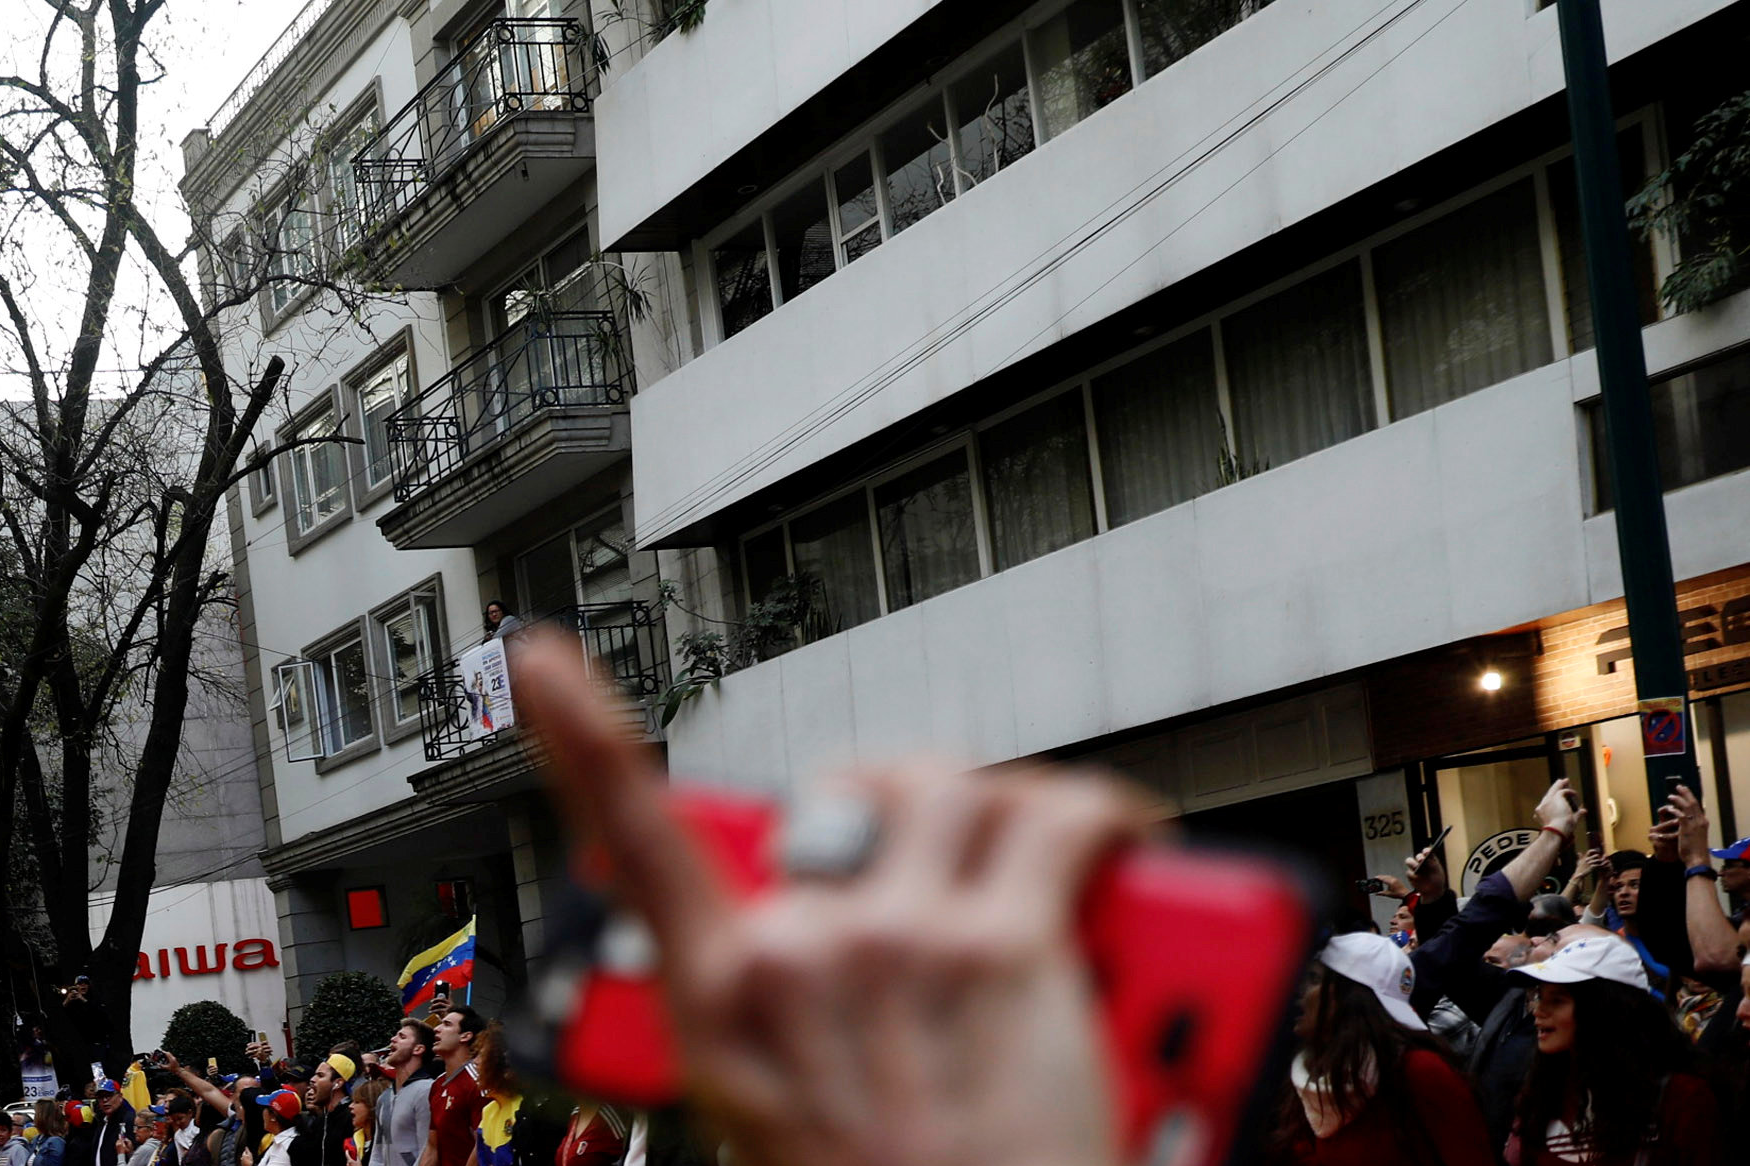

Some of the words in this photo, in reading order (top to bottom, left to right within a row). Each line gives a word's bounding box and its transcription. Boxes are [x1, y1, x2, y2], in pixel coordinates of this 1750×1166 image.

[1364, 811, 1405, 840] 325
[131, 938, 280, 981] aiwa
[24, 1086, 38, 1097] 23
